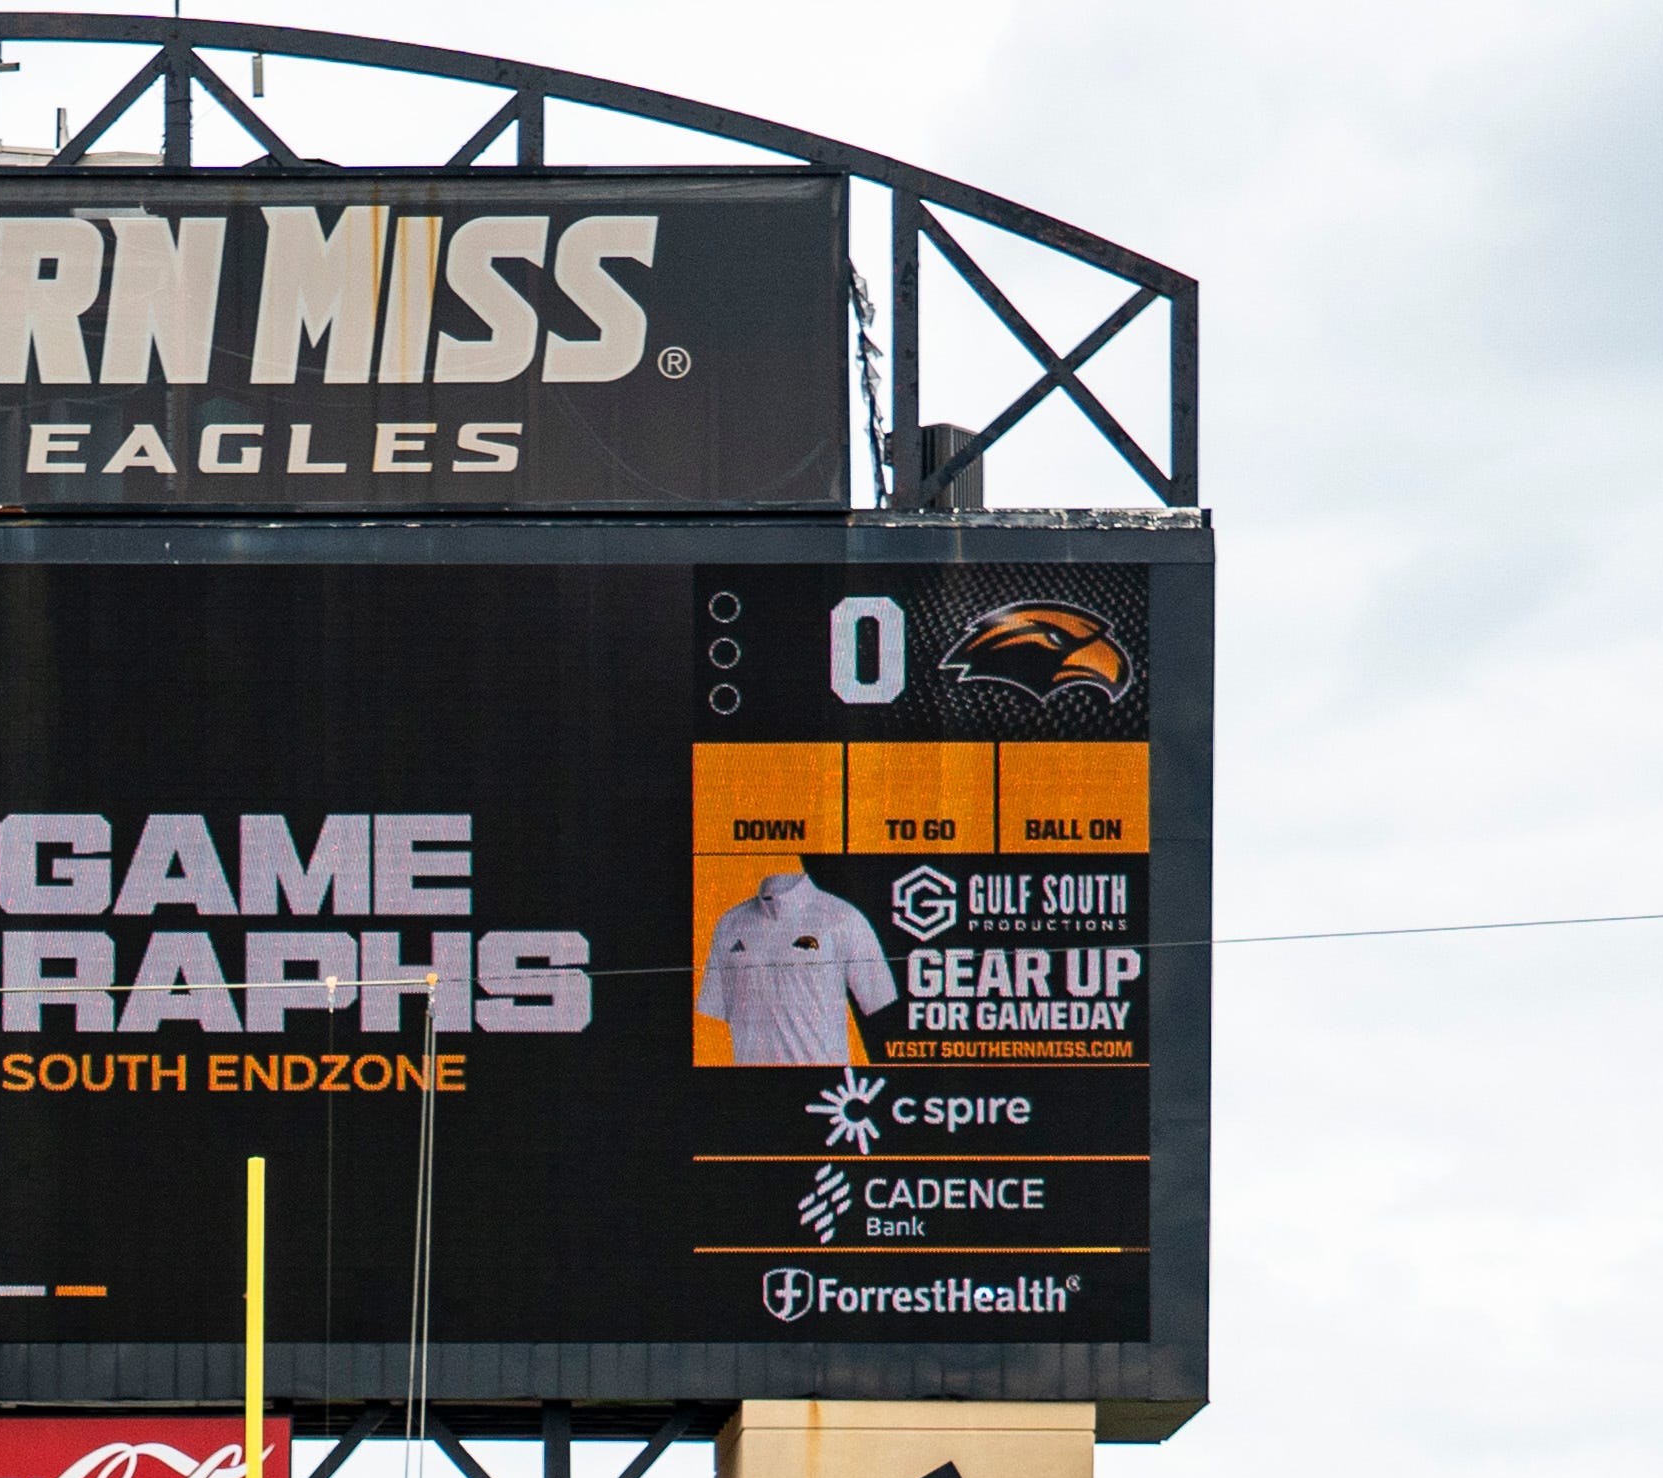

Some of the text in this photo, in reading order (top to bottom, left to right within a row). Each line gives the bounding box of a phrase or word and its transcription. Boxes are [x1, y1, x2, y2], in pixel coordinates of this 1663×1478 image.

[251, 204, 660, 384] MISS
[25, 422, 524, 474] EAGLES
[829, 596, 906, 704] 0
[733, 819, 806, 841] DOWN
[885, 819, 956, 841] TO GO
[1025, 819, 1122, 841] BALL ON
[969, 873, 1127, 916] GULF SOUTH
[968, 919, 1127, 932] PRODUCTIONS
[907, 948, 1141, 999] GEAR UP
[908, 1001, 1130, 1031] FOR GAMEDAY
[885, 1040, 1133, 1059] VISIT SOUTHERNMISS.COM
[0, 1052, 189, 1092] SOUTH
[209, 1054, 467, 1093] ENDZONE
[922, 1096, 1032, 1133] spire
[863, 1178, 1045, 1210] CADENCE
[866, 1216, 926, 1237] Bank
